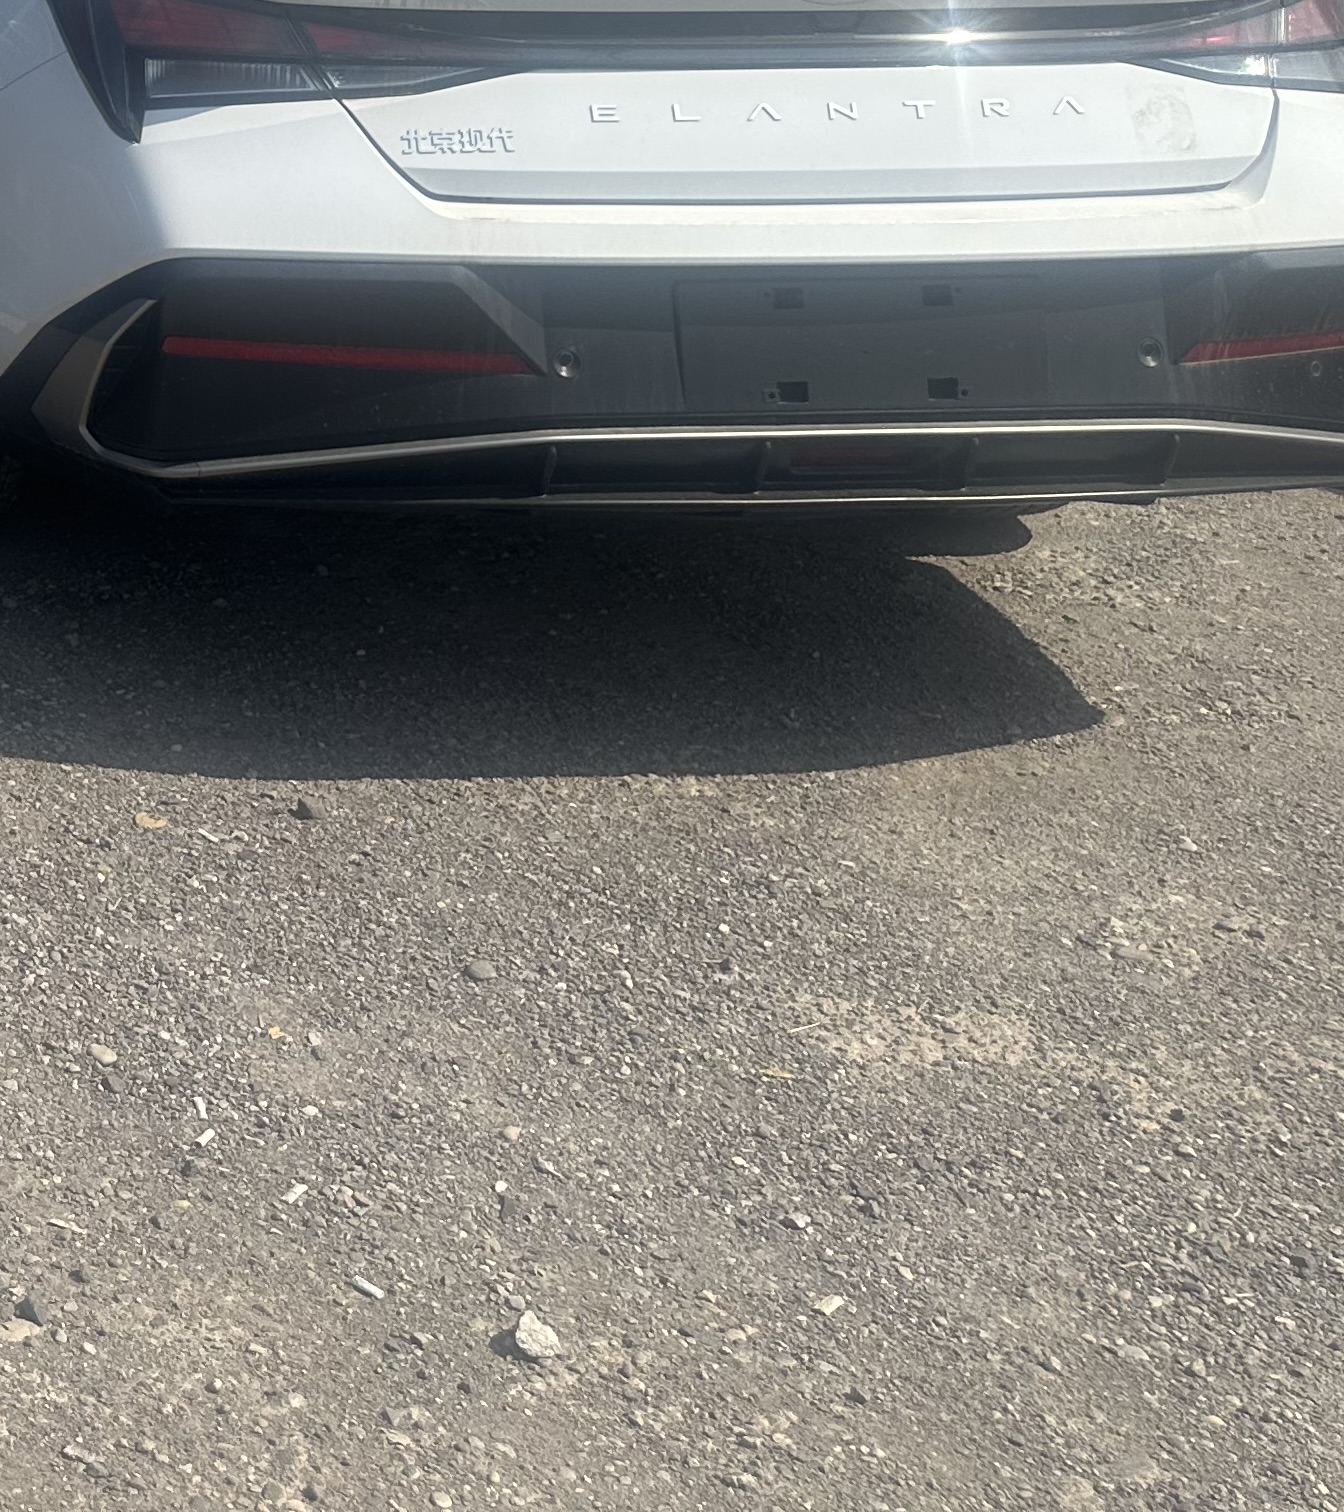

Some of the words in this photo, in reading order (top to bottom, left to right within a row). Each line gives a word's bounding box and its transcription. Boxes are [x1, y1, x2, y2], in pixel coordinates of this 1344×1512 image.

[588, 95, 1086, 123] ELANTRA
[400, 127, 515, 155] 北京现代
